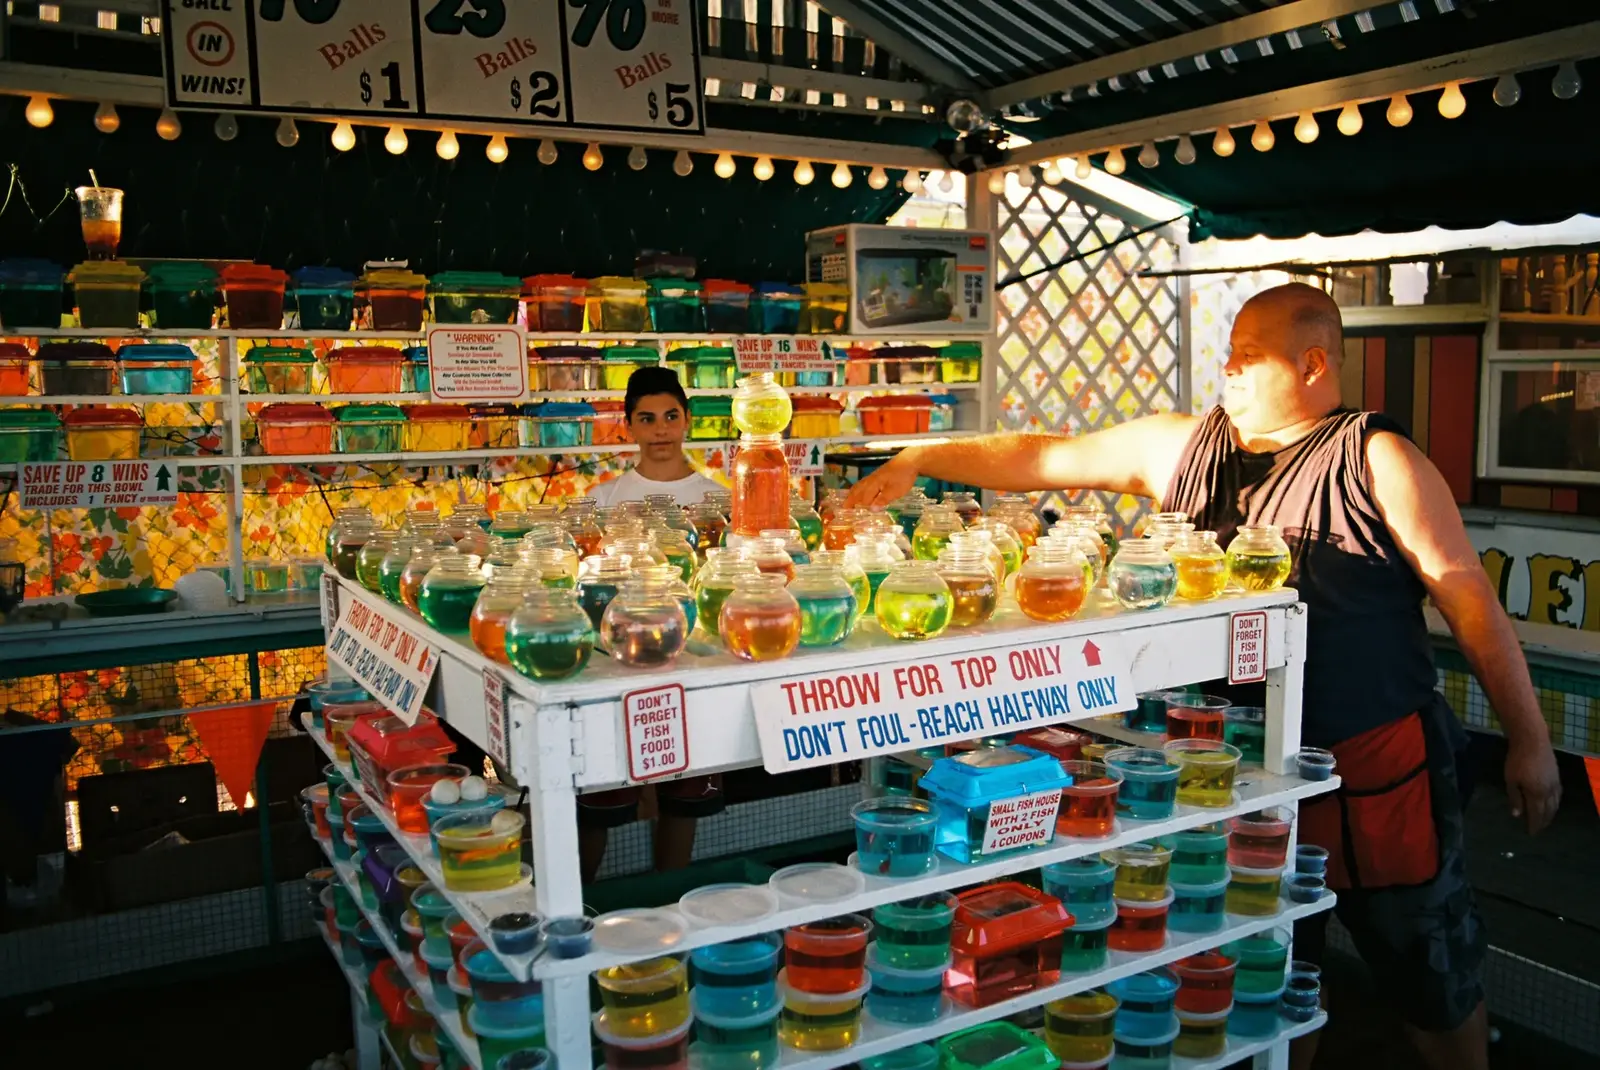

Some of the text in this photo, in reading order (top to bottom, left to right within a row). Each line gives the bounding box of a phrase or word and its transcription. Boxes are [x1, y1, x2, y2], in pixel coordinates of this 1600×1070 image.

[424, 0, 507, 38] 25
[569, 0, 646, 51] 70
[651, 11, 679, 25] MORE
[198, 33, 222, 52] IN
[317, 22, 387, 70] Balls
[473, 37, 538, 79] Balls
[614, 52, 672, 89] Balls
[181, 75, 245, 96] WINS!
[453, 334, 495, 343] WARNING
[736, 339, 818, 352] SAVE UP 16 WINS
[784, 443, 807, 457] WINS
[23, 463, 149, 484] SAVE UP 8 WINS
[24, 482, 144, 495] TRADE FOR THIS BOWL
[24, 495, 78, 506] INCLUDES
[88, 495, 94, 504] 1
[104, 494, 138, 504] FANCY
[345, 599, 372, 633] THROW
[366, 613, 385, 643] FOR
[380, 621, 399, 651] TOP
[394, 631, 419, 665] ONLY
[1239, 618, 1259, 629] DON'T
[1236, 629, 1262, 641] FORGET
[1241, 642, 1257, 652] FISH
[1238, 653, 1259, 663] FOOD!
[1238, 664, 1258, 676] $1.00
[370, 660, 404, 701] HALFWAY
[396, 679, 420, 713] ONLY
[780, 644, 1065, 715] THROW FOR TOP ONLY
[638, 693, 671, 711] DON'T
[633, 707, 677, 726] FORGET
[783, 720, 848, 761] DON'T
[987, 684, 1071, 727] HALFWAY
[1077, 675, 1120, 710] ONLY
[644, 723, 670, 739] FISH
[640, 737, 675, 755] FOOD!
[643, 752, 675, 770] $1.00
[991, 793, 1060, 816] SMALL FISH HOUSE
[990, 807, 1055, 828] WITH 2 FISH
[997, 819, 1045, 835] ONLY
[990, 829, 1046, 849] 4 COUPONS
